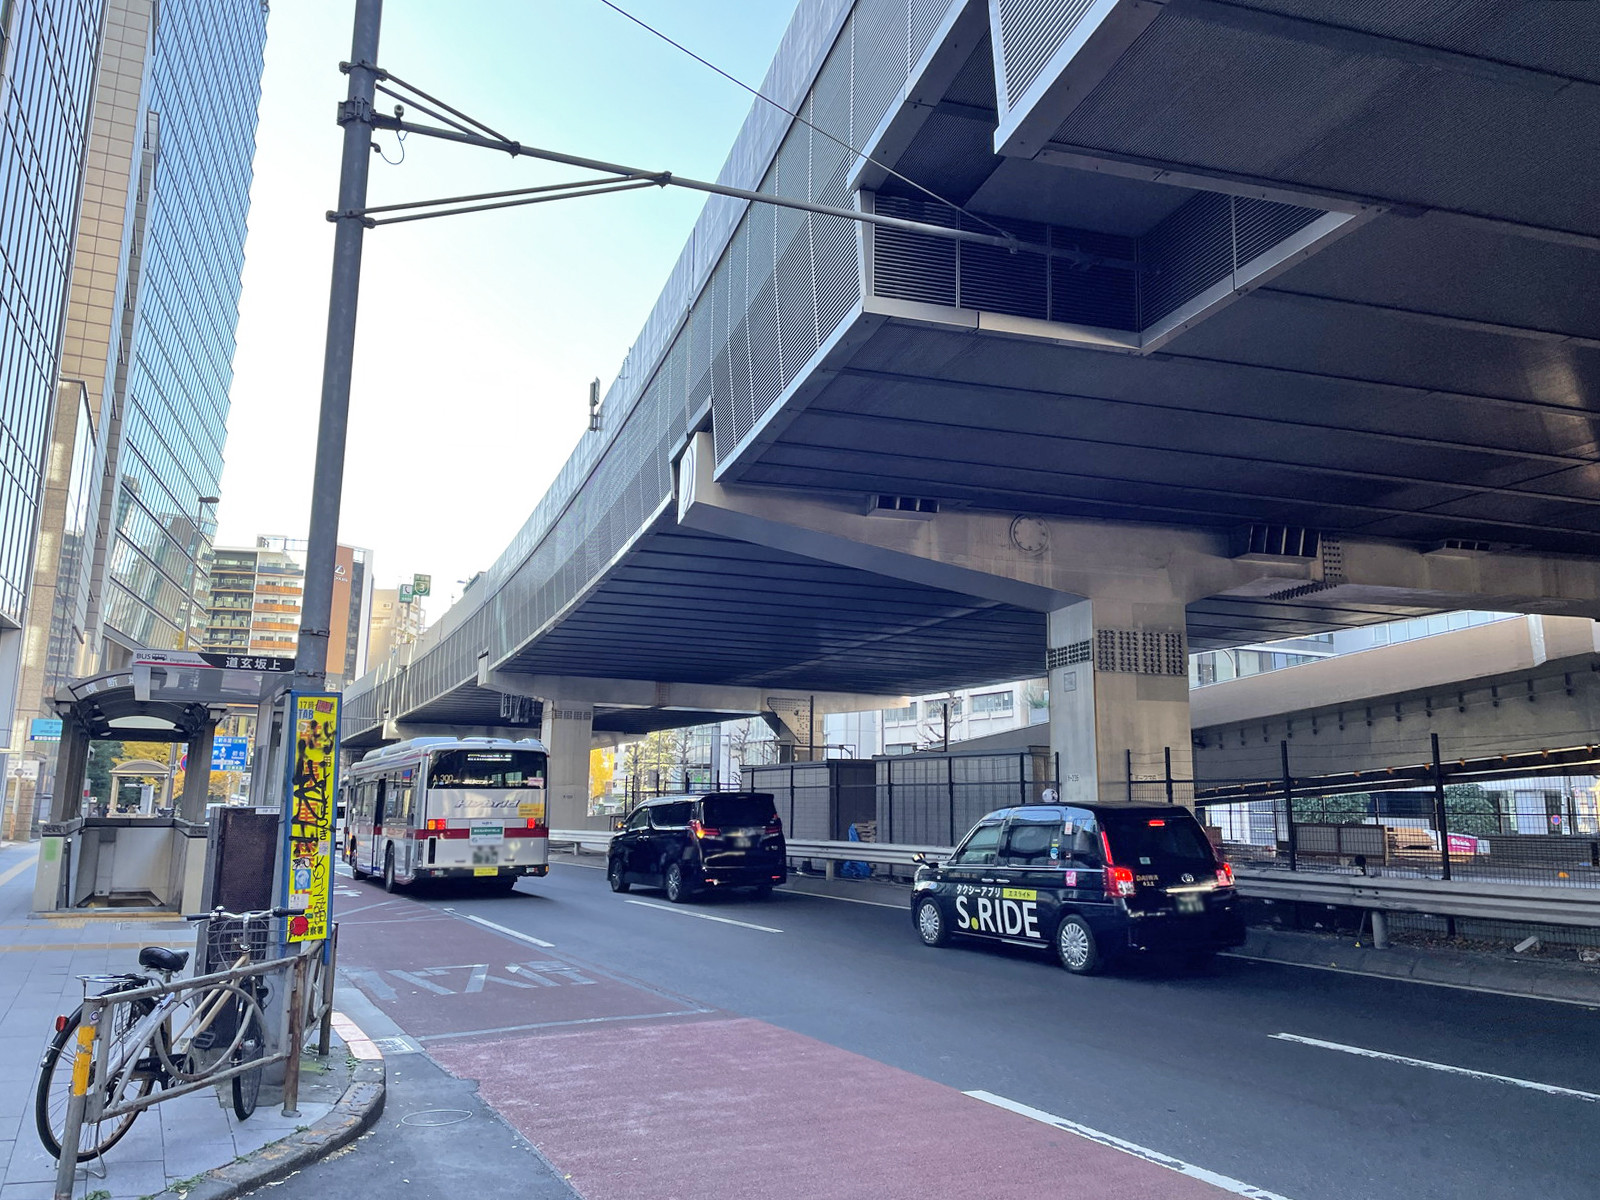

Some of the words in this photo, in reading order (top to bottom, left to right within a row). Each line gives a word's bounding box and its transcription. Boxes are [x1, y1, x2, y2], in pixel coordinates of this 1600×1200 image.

[419, 583, 425, 592] 3
[136, 652, 152, 660] BUS
[225, 656, 281, 671] 道玄坂上
[297, 708, 314, 720] TAB
[432, 774, 438, 782] A
[454, 799, 521, 808] Hybrid
[956, 884, 1001, 898] タクシーアプリ
[1008, 890, 1031, 898] エスライド
[955, 895, 1041, 938] S.RIDE
